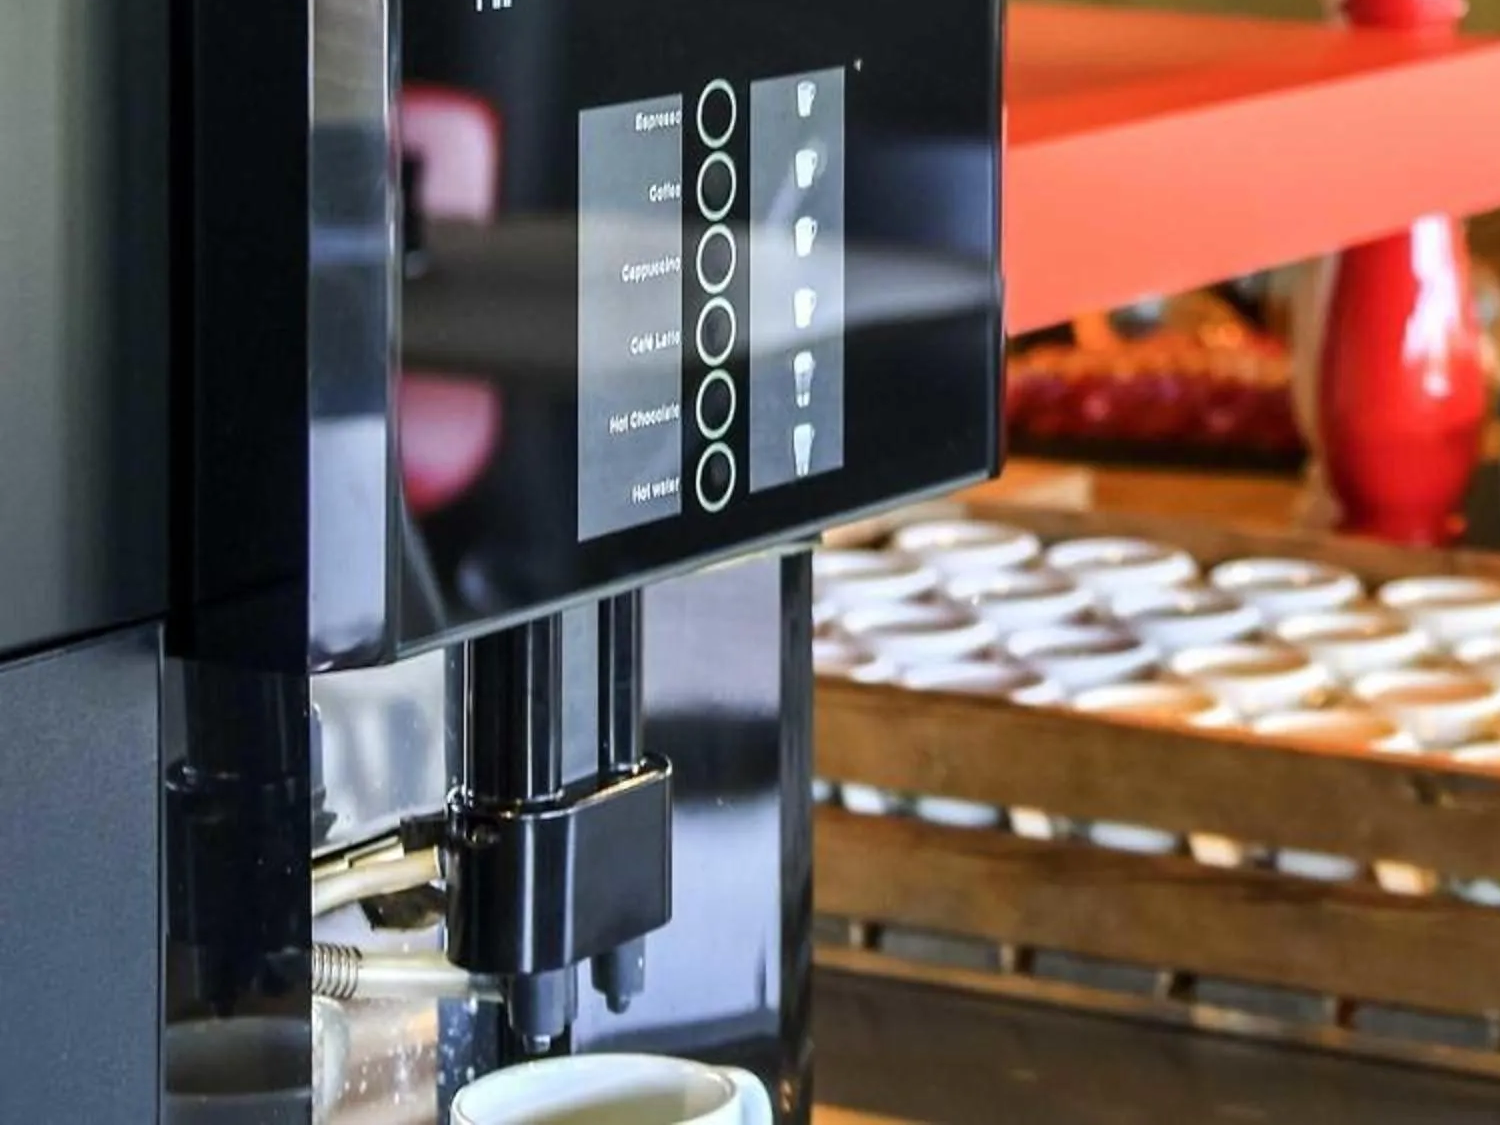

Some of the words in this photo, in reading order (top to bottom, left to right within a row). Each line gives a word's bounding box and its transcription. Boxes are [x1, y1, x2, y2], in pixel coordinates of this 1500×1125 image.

[635, 110, 681, 132] Espresso
[649, 184, 681, 202] Coffee
[622, 256, 681, 283] Cappuccino
[609, 415, 629, 434] Hot
[630, 403, 680, 429] Chocolate
[632, 482, 651, 504] Hot
